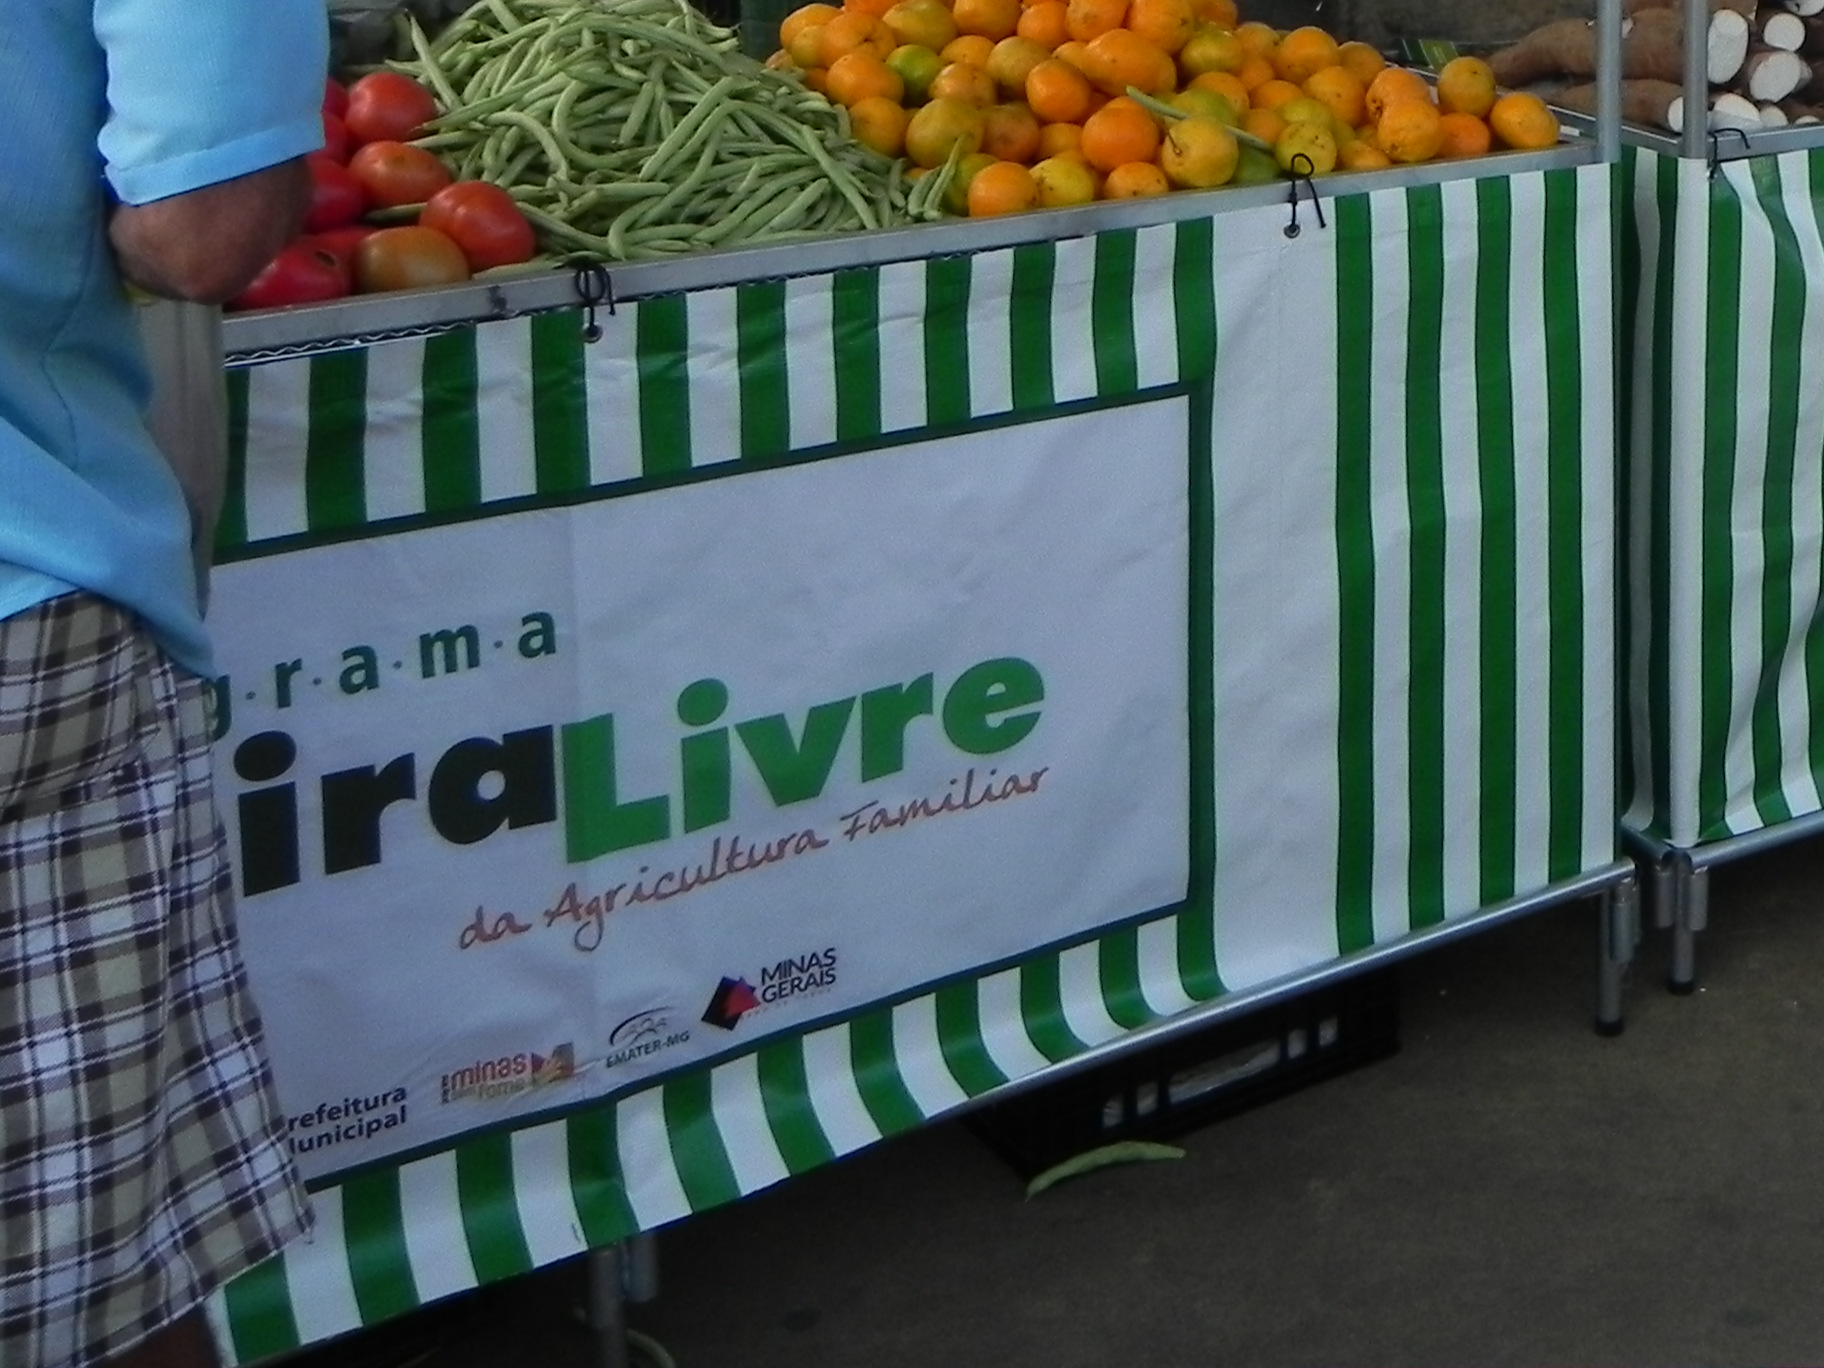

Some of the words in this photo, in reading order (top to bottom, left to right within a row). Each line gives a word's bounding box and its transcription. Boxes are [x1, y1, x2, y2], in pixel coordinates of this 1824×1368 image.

[233, 655, 1046, 898] iraLivre
[457, 905, 533, 951] da
[543, 826, 831, 953] Agricultura
[838, 763, 1051, 843] Familiar
[760, 946, 838, 986] MINAS
[761, 966, 838, 1005] GERAIS
[606, 1031, 691, 1069] EMATER-MG
[450, 1052, 529, 1090] minas
[288, 1086, 408, 1132] refeitura
